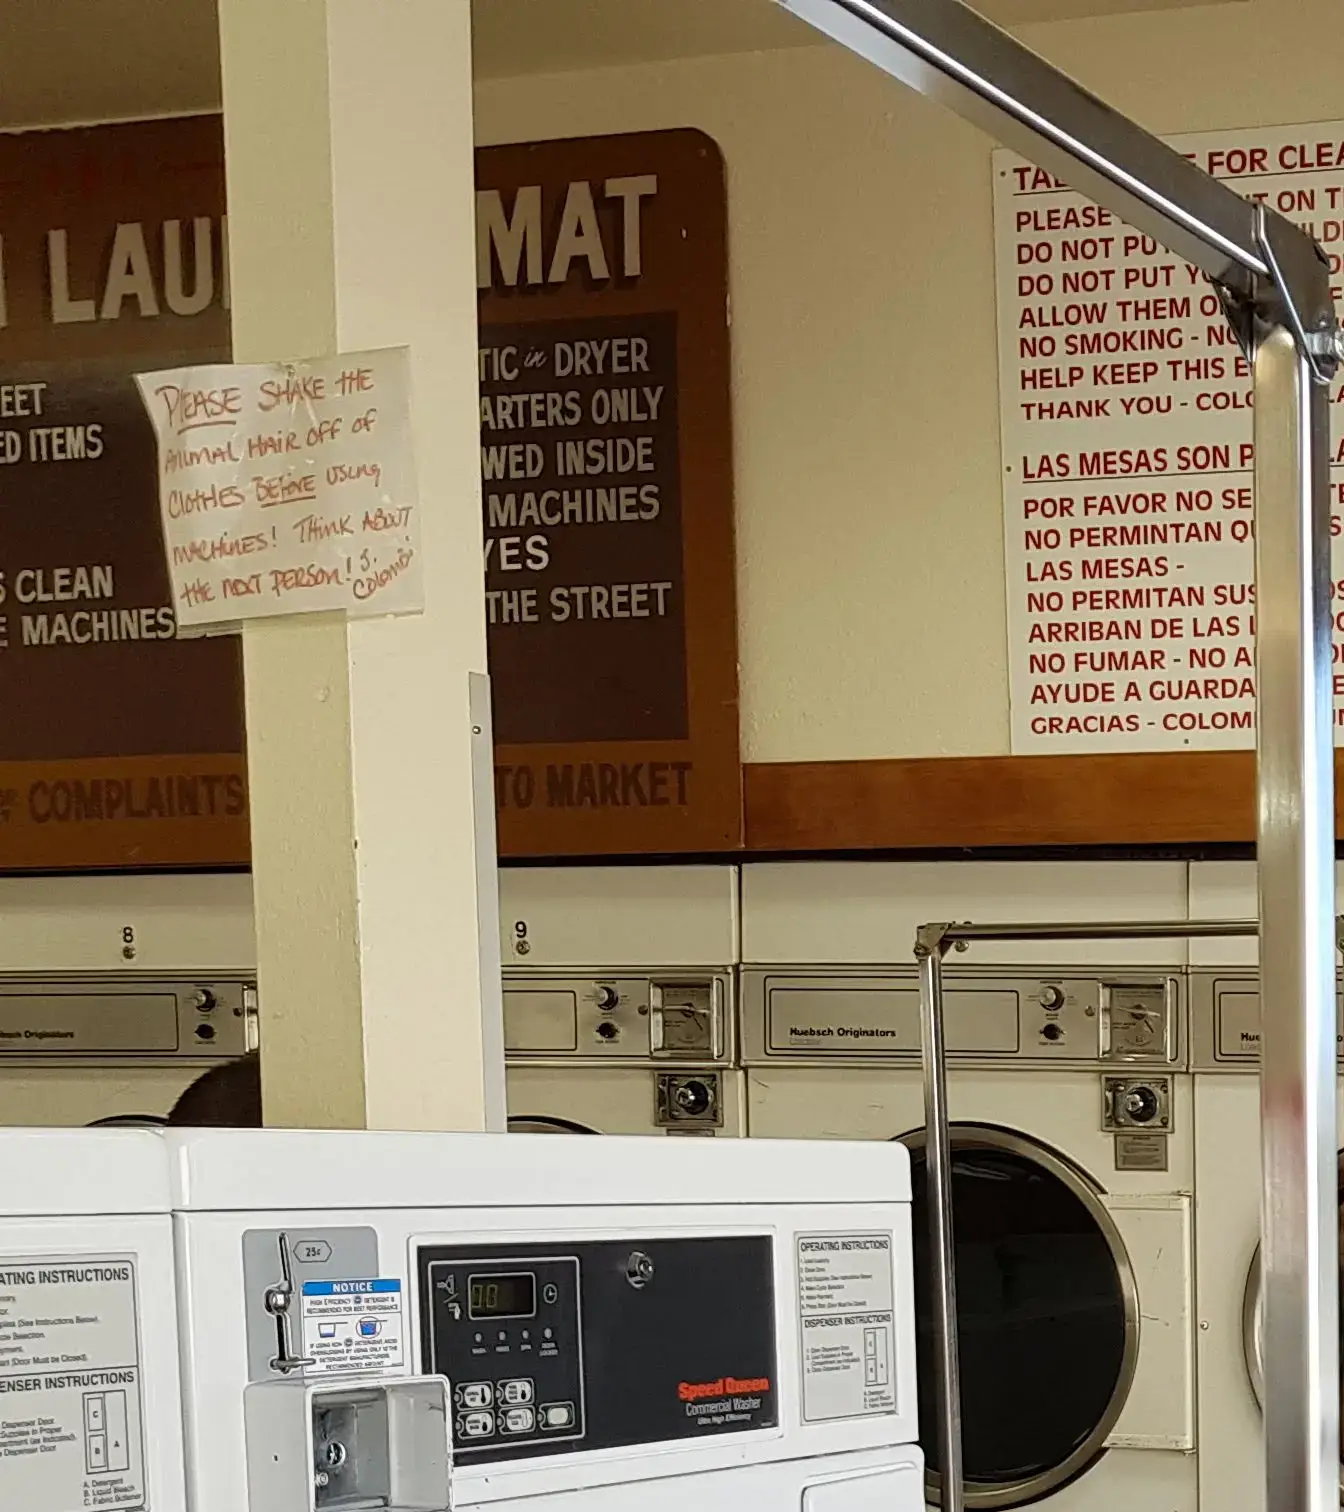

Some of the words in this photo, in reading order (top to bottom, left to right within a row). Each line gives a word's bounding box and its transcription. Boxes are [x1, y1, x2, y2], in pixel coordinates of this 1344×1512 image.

[1207, 147, 1268, 174] FOR
[1016, 206, 1111, 231] PLEASE
[1277, 191, 1315, 213] ON
[1017, 241, 1053, 265] DO
[1061, 237, 1115, 262] NOT
[48, 214, 231, 323] LAU
[1018, 273, 1054, 297] DO
[1062, 269, 1116, 293] NOT
[1124, 264, 1175, 289] PUT
[1020, 303, 1107, 328] ALLOW
[1115, 296, 1191, 322] THEM
[523, 346, 548, 368] in
[554, 337, 650, 377] DRYER
[1019, 335, 1056, 359] NO
[1065, 327, 1183, 356] SMOKING
[1021, 366, 1085, 391] HELP
[1093, 361, 1159, 385] KEEP
[1167, 357, 1225, 381] THIS
[155, 385, 242, 428] PLEASE
[258, 376, 326, 411] SHAKE
[335, 369, 375, 397] THE
[591, 386, 664, 425] ONLY
[1023, 399, 1108, 419] THANK
[1120, 396, 1172, 415] YOU
[29, 424, 104, 462] ITEMS
[556, 437, 654, 476] INSIDE
[1023, 453, 1070, 479] LAS
[1079, 447, 1168, 476] MESAS
[1176, 445, 1230, 471] SON
[488, 484, 660, 527] MACHINES
[1023, 497, 1075, 519] POR
[1083, 492, 1167, 517] FAVOR
[1175, 489, 1213, 512] NO
[1221, 488, 1252, 510] SE
[1024, 528, 1061, 550] NO
[1069, 521, 1222, 548] PERMINTAN
[1026, 560, 1073, 582] LAS
[1081, 555, 1169, 580] MESAS
[15, 565, 114, 603] CLEAN
[485, 588, 539, 624] THE
[551, 581, 673, 622] STREET
[1027, 591, 1064, 613] NO
[1072, 586, 1205, 611] PERMITAN
[21, 606, 176, 646] MACHINES
[1029, 619, 1142, 643] ARRIBAN
[1150, 617, 1184, 639] DE
[1192, 615, 1240, 638] LAS
[1029, 652, 1066, 674] NO
[1074, 649, 1166, 672] FUMAR
[1189, 647, 1226, 669] NO
[1031, 682, 1115, 704] AYUDE
[1124, 681, 1142, 702] A
[1030, 714, 1140, 735] GRACIAS
[1163, 711, 1257, 731] COLOM
[29, 773, 246, 824] COMPLAINTS
[495, 764, 535, 808] TO
[546, 762, 693, 807] MARKET
[122, 926, 134, 943] 8
[515, 921, 527, 938] 9
[837, 1027, 897, 1039] Originators
[800, 1241, 839, 1252] OPERATING
[841, 1240, 888, 1250] INSTRUCTIONS
[39, 1267, 129, 1284] INSTRUCTIONS
[333, 1282, 373, 1292] NOTICE
[45, 1371, 134, 1389] INSTRUCTIONS
[679, 1378, 724, 1401] Speed
[725, 1377, 769, 1393] Queen
[686, 1399, 731, 1416] Commercial
[733, 1397, 761, 1410] Washer
